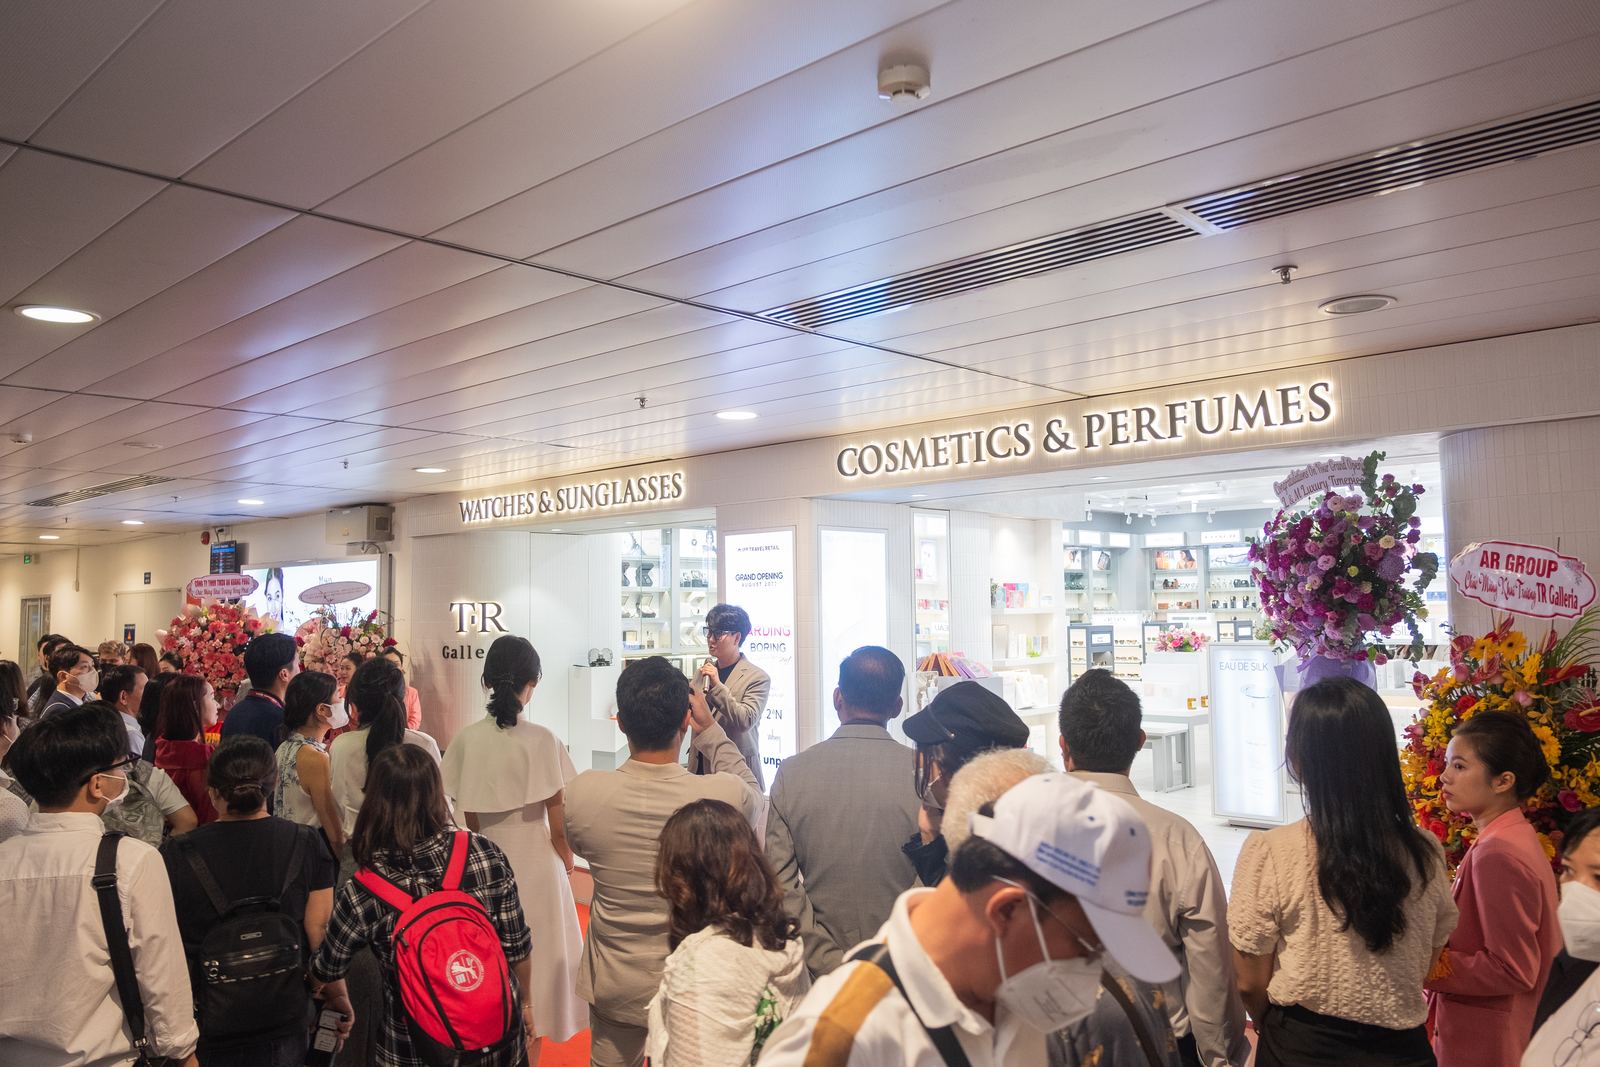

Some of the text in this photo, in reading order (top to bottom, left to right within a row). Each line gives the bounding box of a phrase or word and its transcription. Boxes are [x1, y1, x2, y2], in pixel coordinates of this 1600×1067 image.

[837, 381, 1332, 478] COSMETICS & PERFUMES
[1328, 459, 1347, 472] Grand
[1301, 480, 1329, 499] Luxury
[459, 473, 683, 523] WATCHES & SUNGLASSES
[1480, 550, 1559, 579] AR GROUP
[735, 571, 783, 582] GRAND OPENING
[1536, 582, 1548, 603] TR
[1548, 584, 1578, 609] Galleria
[748, 625, 791, 637] ARDING
[442, 645, 485, 660] Galle
[750, 642, 787, 653] BORING
[1219, 661, 1269, 672] EAU DE SILK
[763, 756, 782, 768] unp
